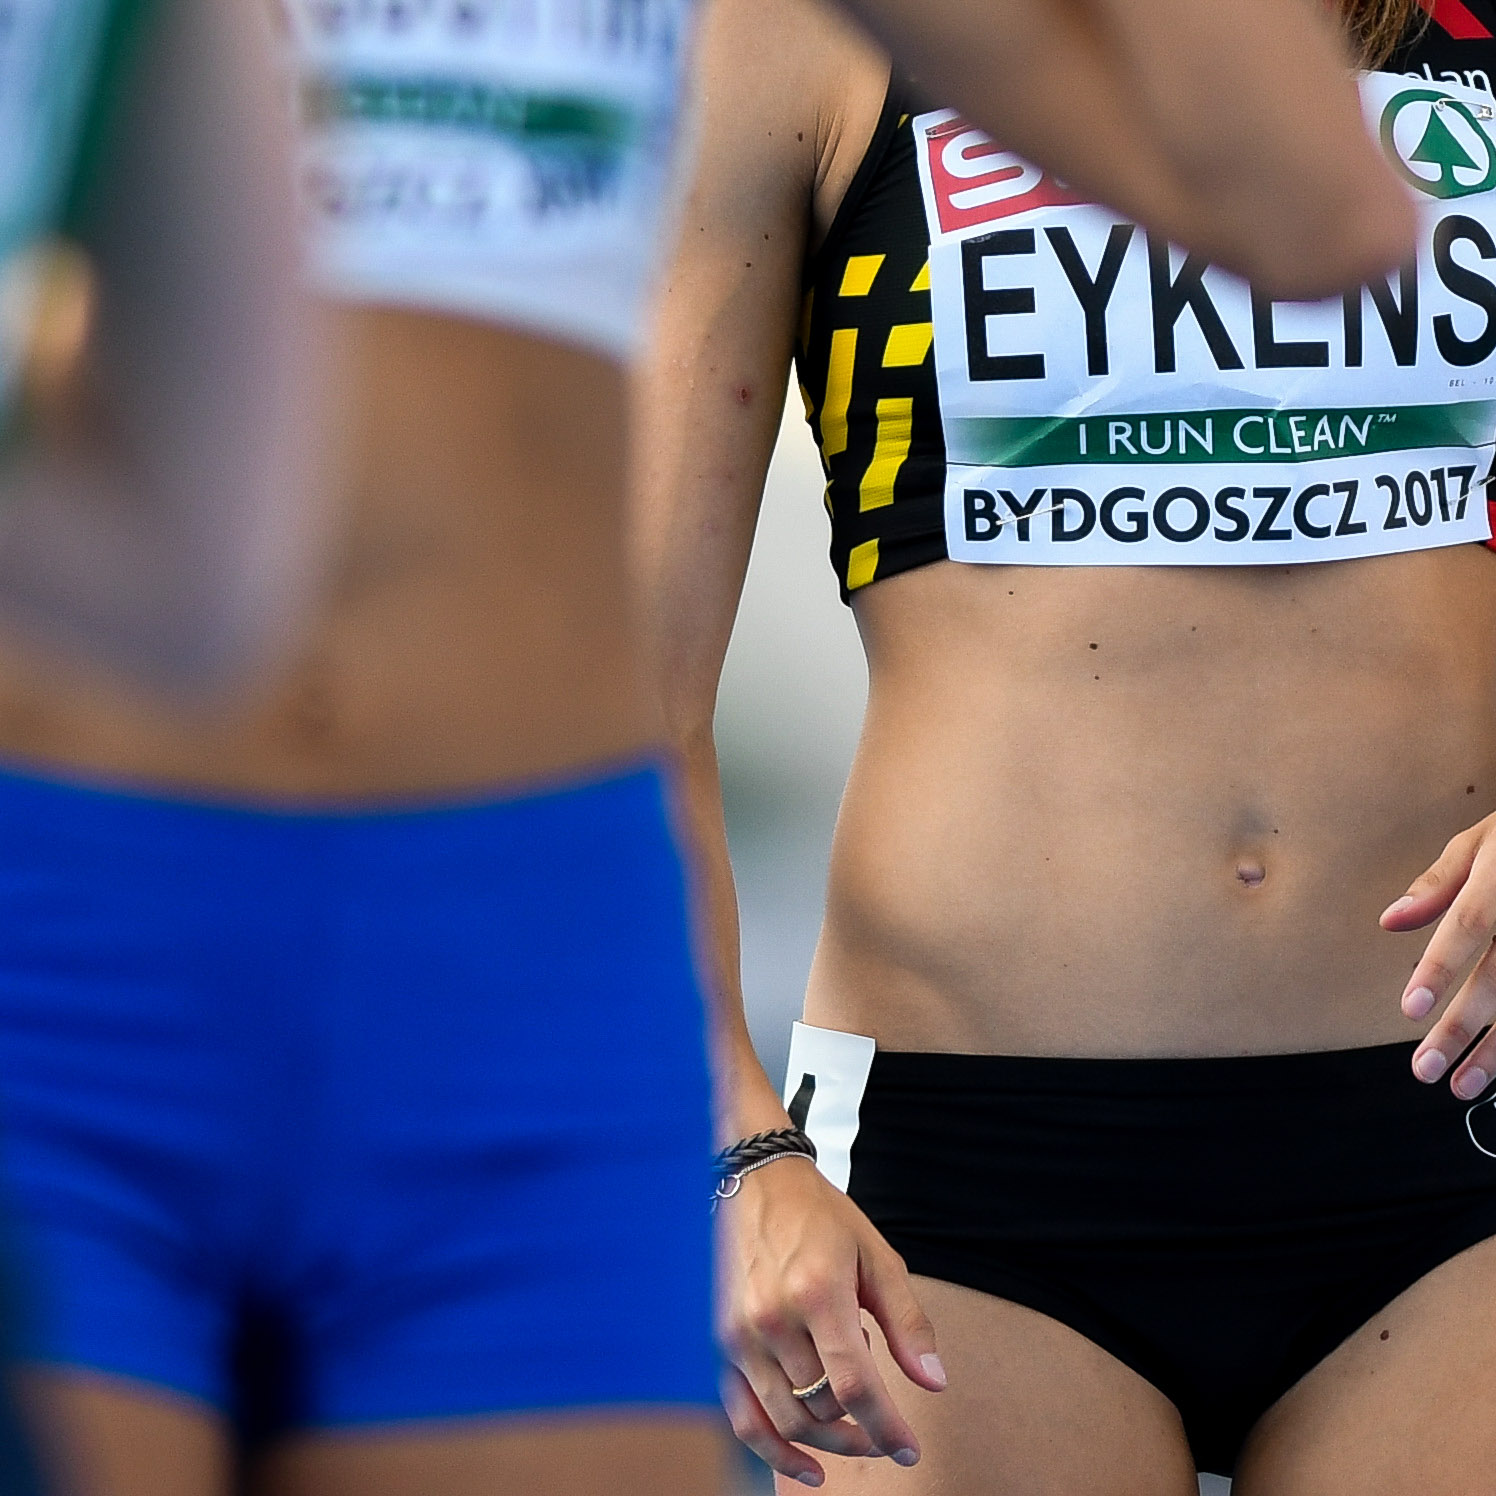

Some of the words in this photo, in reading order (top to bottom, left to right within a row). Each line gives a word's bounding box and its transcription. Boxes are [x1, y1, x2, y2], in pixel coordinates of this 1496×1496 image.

[1079, 423, 1087, 455] I
[1108, 417, 1213, 455] RUN
[963, 479, 1367, 542] BYDGOSZCZ
[1374, 464, 1478, 530] 2017
